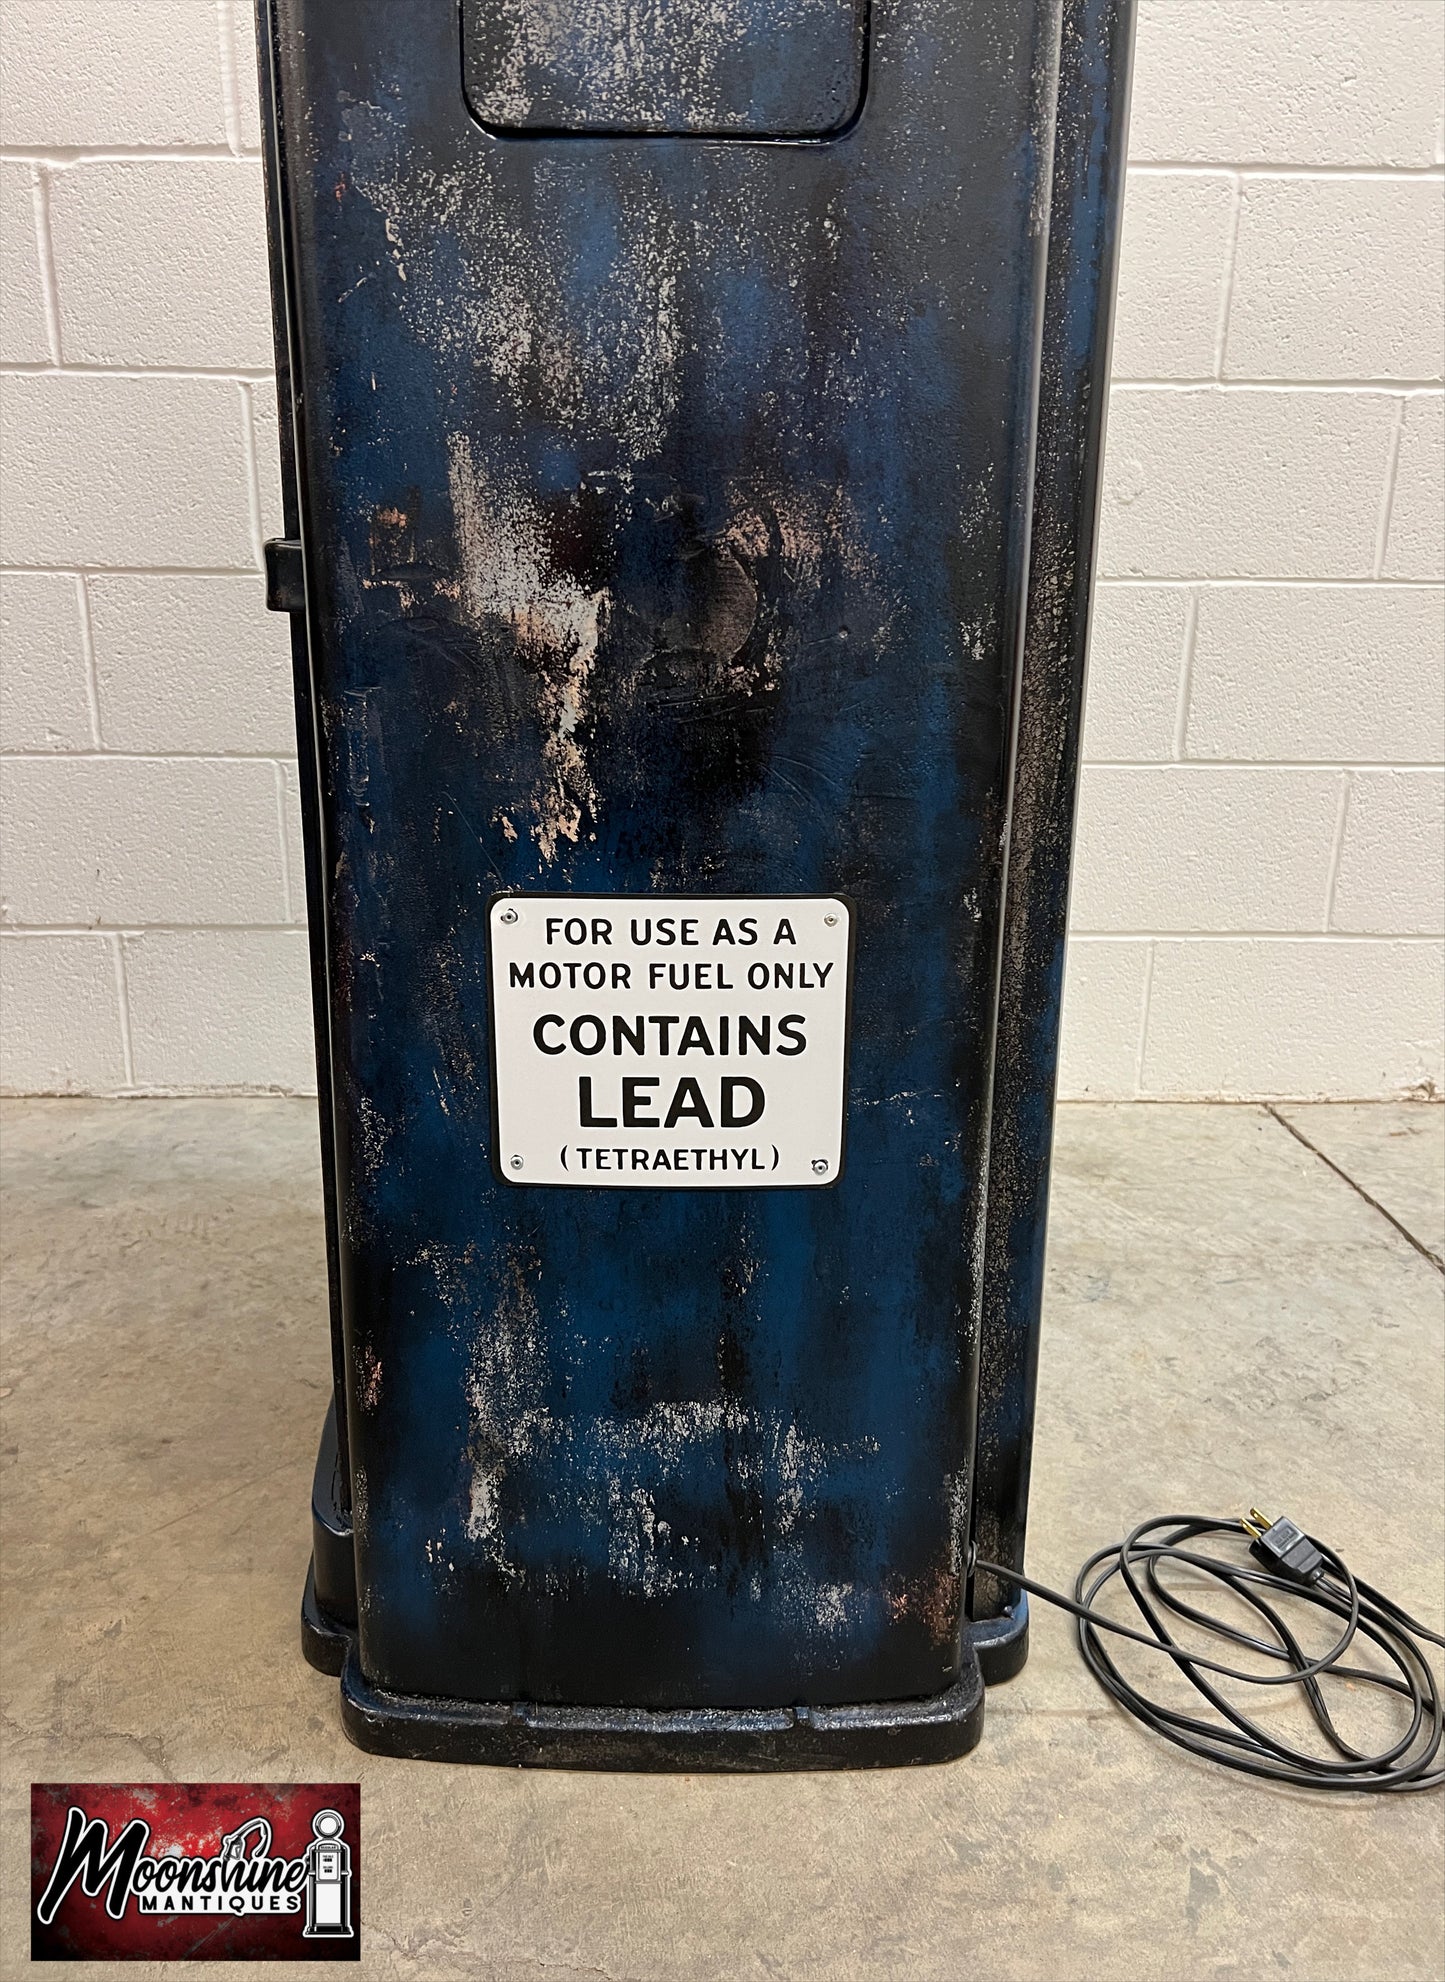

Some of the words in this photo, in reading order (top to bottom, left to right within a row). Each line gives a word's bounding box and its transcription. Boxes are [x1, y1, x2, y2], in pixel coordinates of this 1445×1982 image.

[546, 917, 613, 946] FOR
[630, 918, 699, 946] USE
[712, 917, 758, 946] AS
[773, 918, 797, 945] A
[509, 961, 631, 990] MOTOR
[649, 963, 734, 990] FUEL
[747, 962, 834, 990] ONLY
[533, 1013, 807, 1056] CONTAINS
[578, 1076, 766, 1129] LEAD
